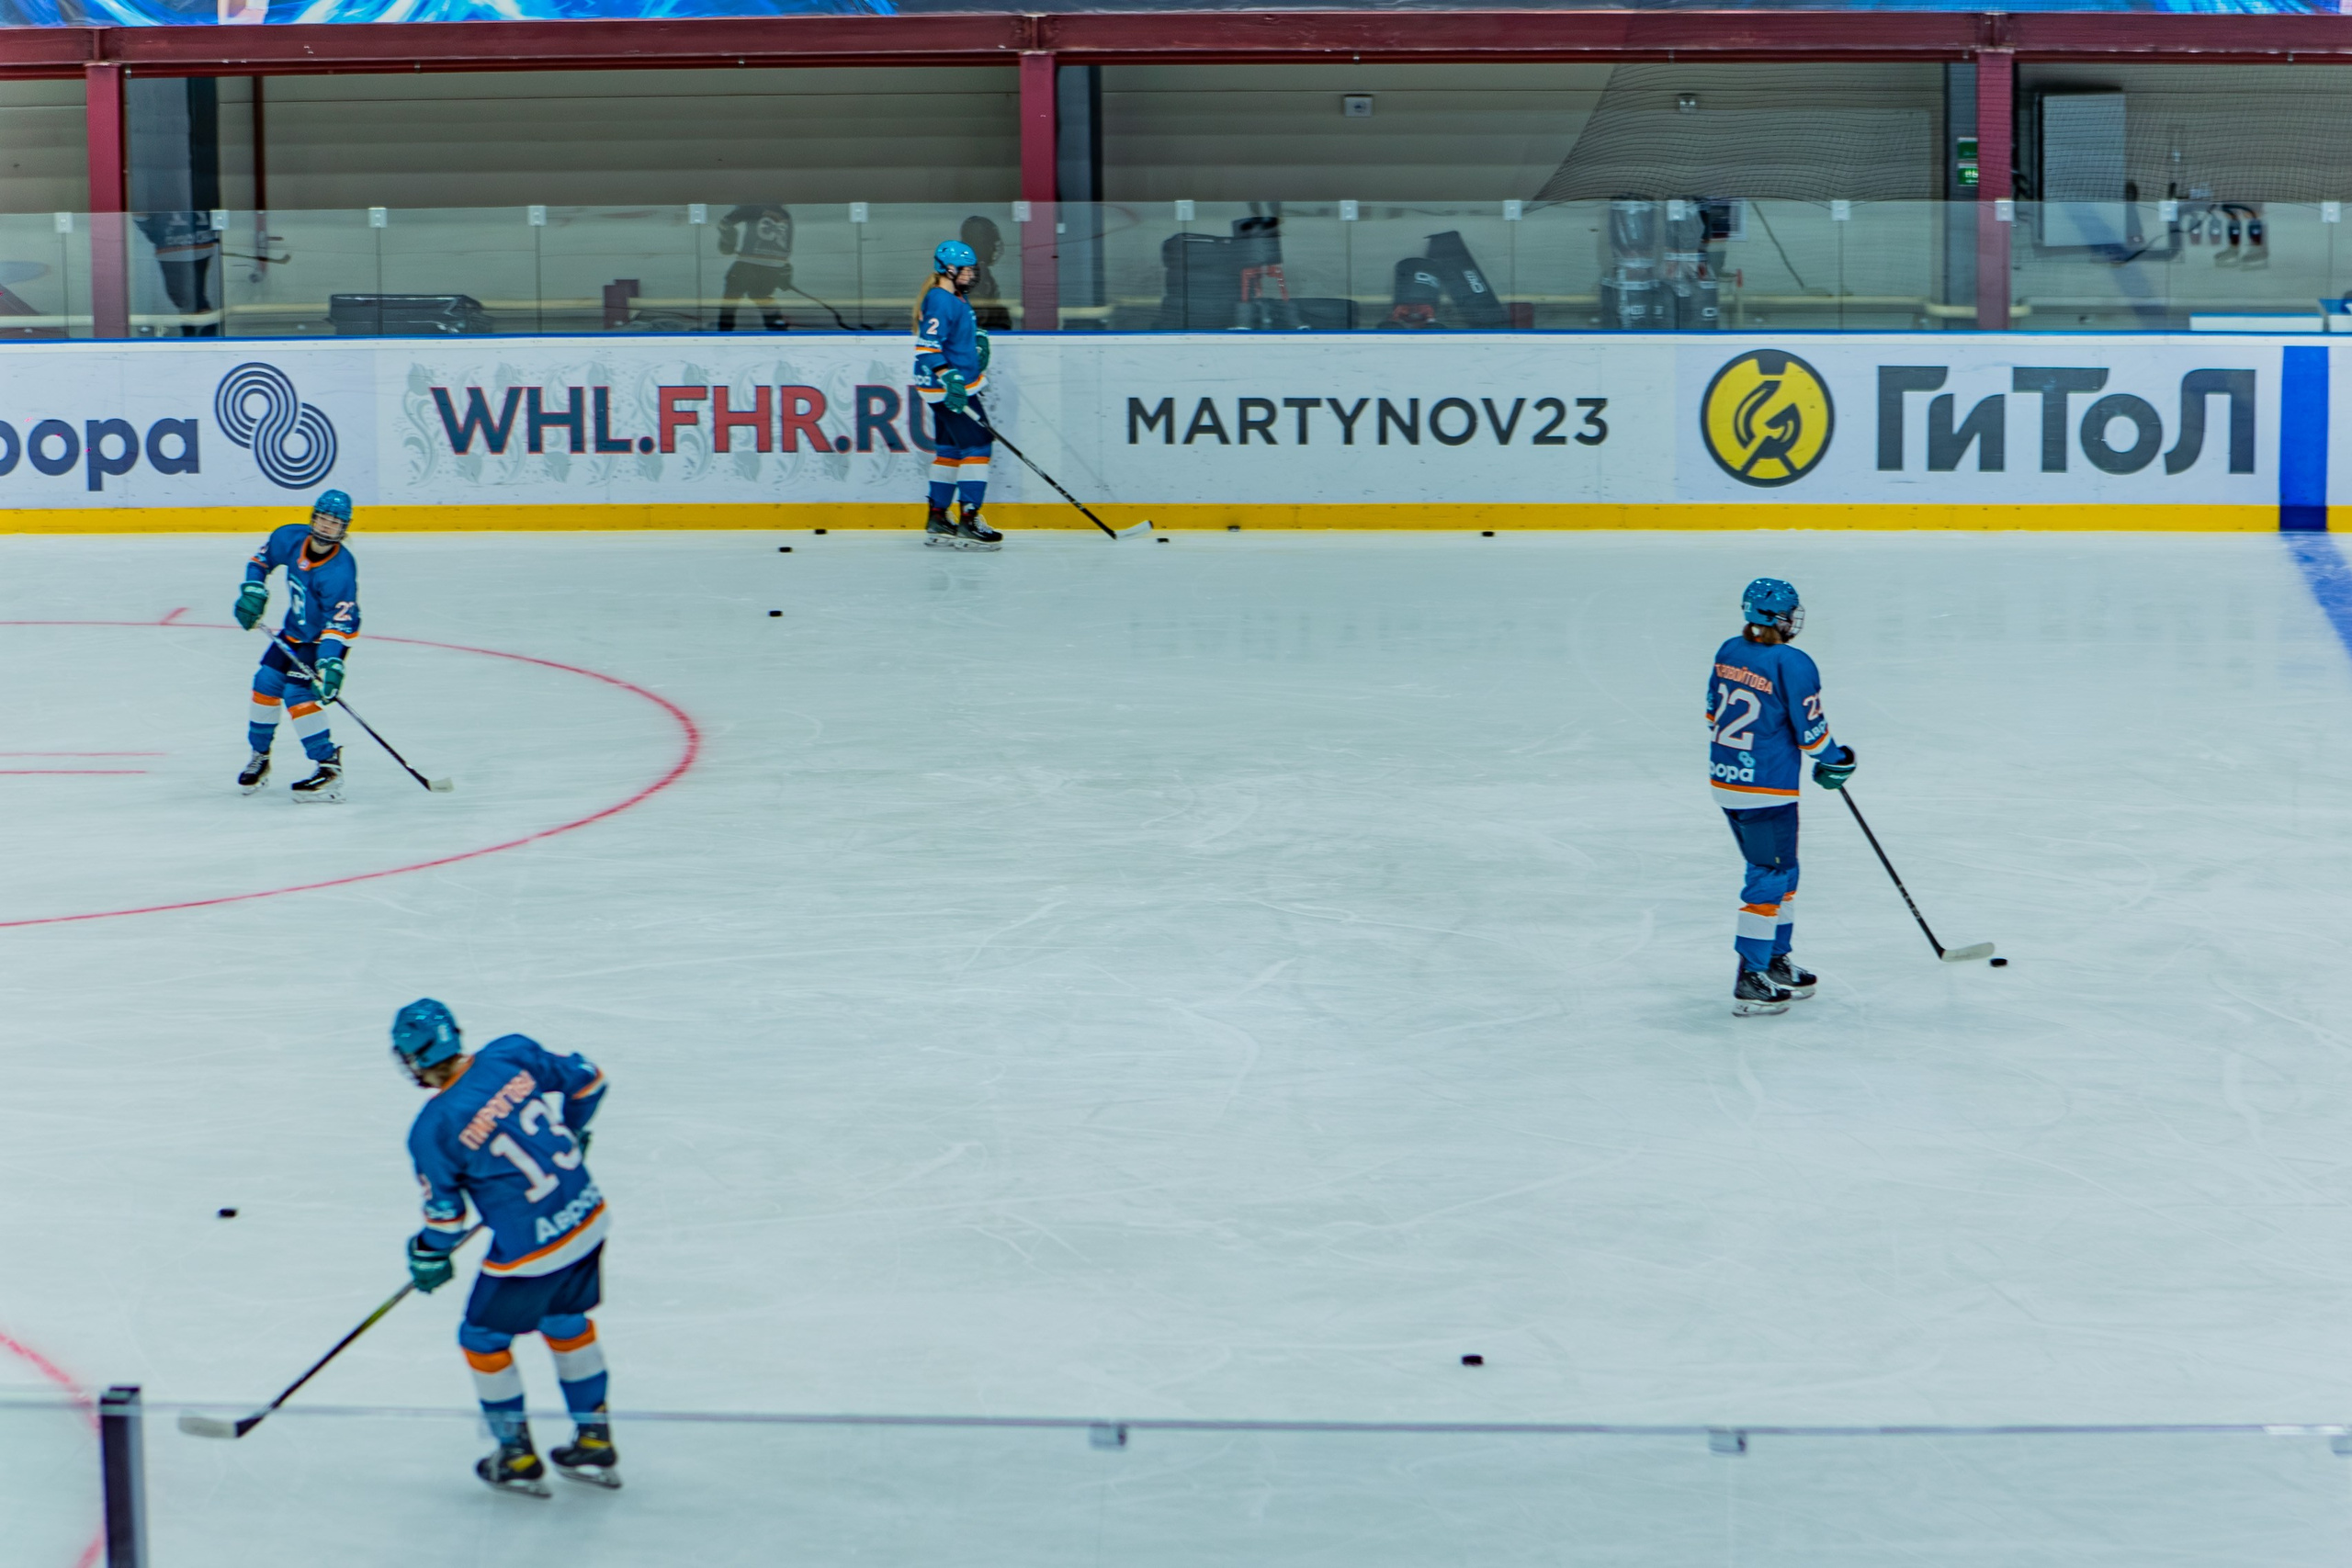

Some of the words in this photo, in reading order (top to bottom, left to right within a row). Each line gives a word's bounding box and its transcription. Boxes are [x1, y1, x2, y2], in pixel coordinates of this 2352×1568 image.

[926, 318, 939, 334] 2
[1127, 397, 1609, 446] MARTYNOV23
[490, 1099, 584, 1204] 13
